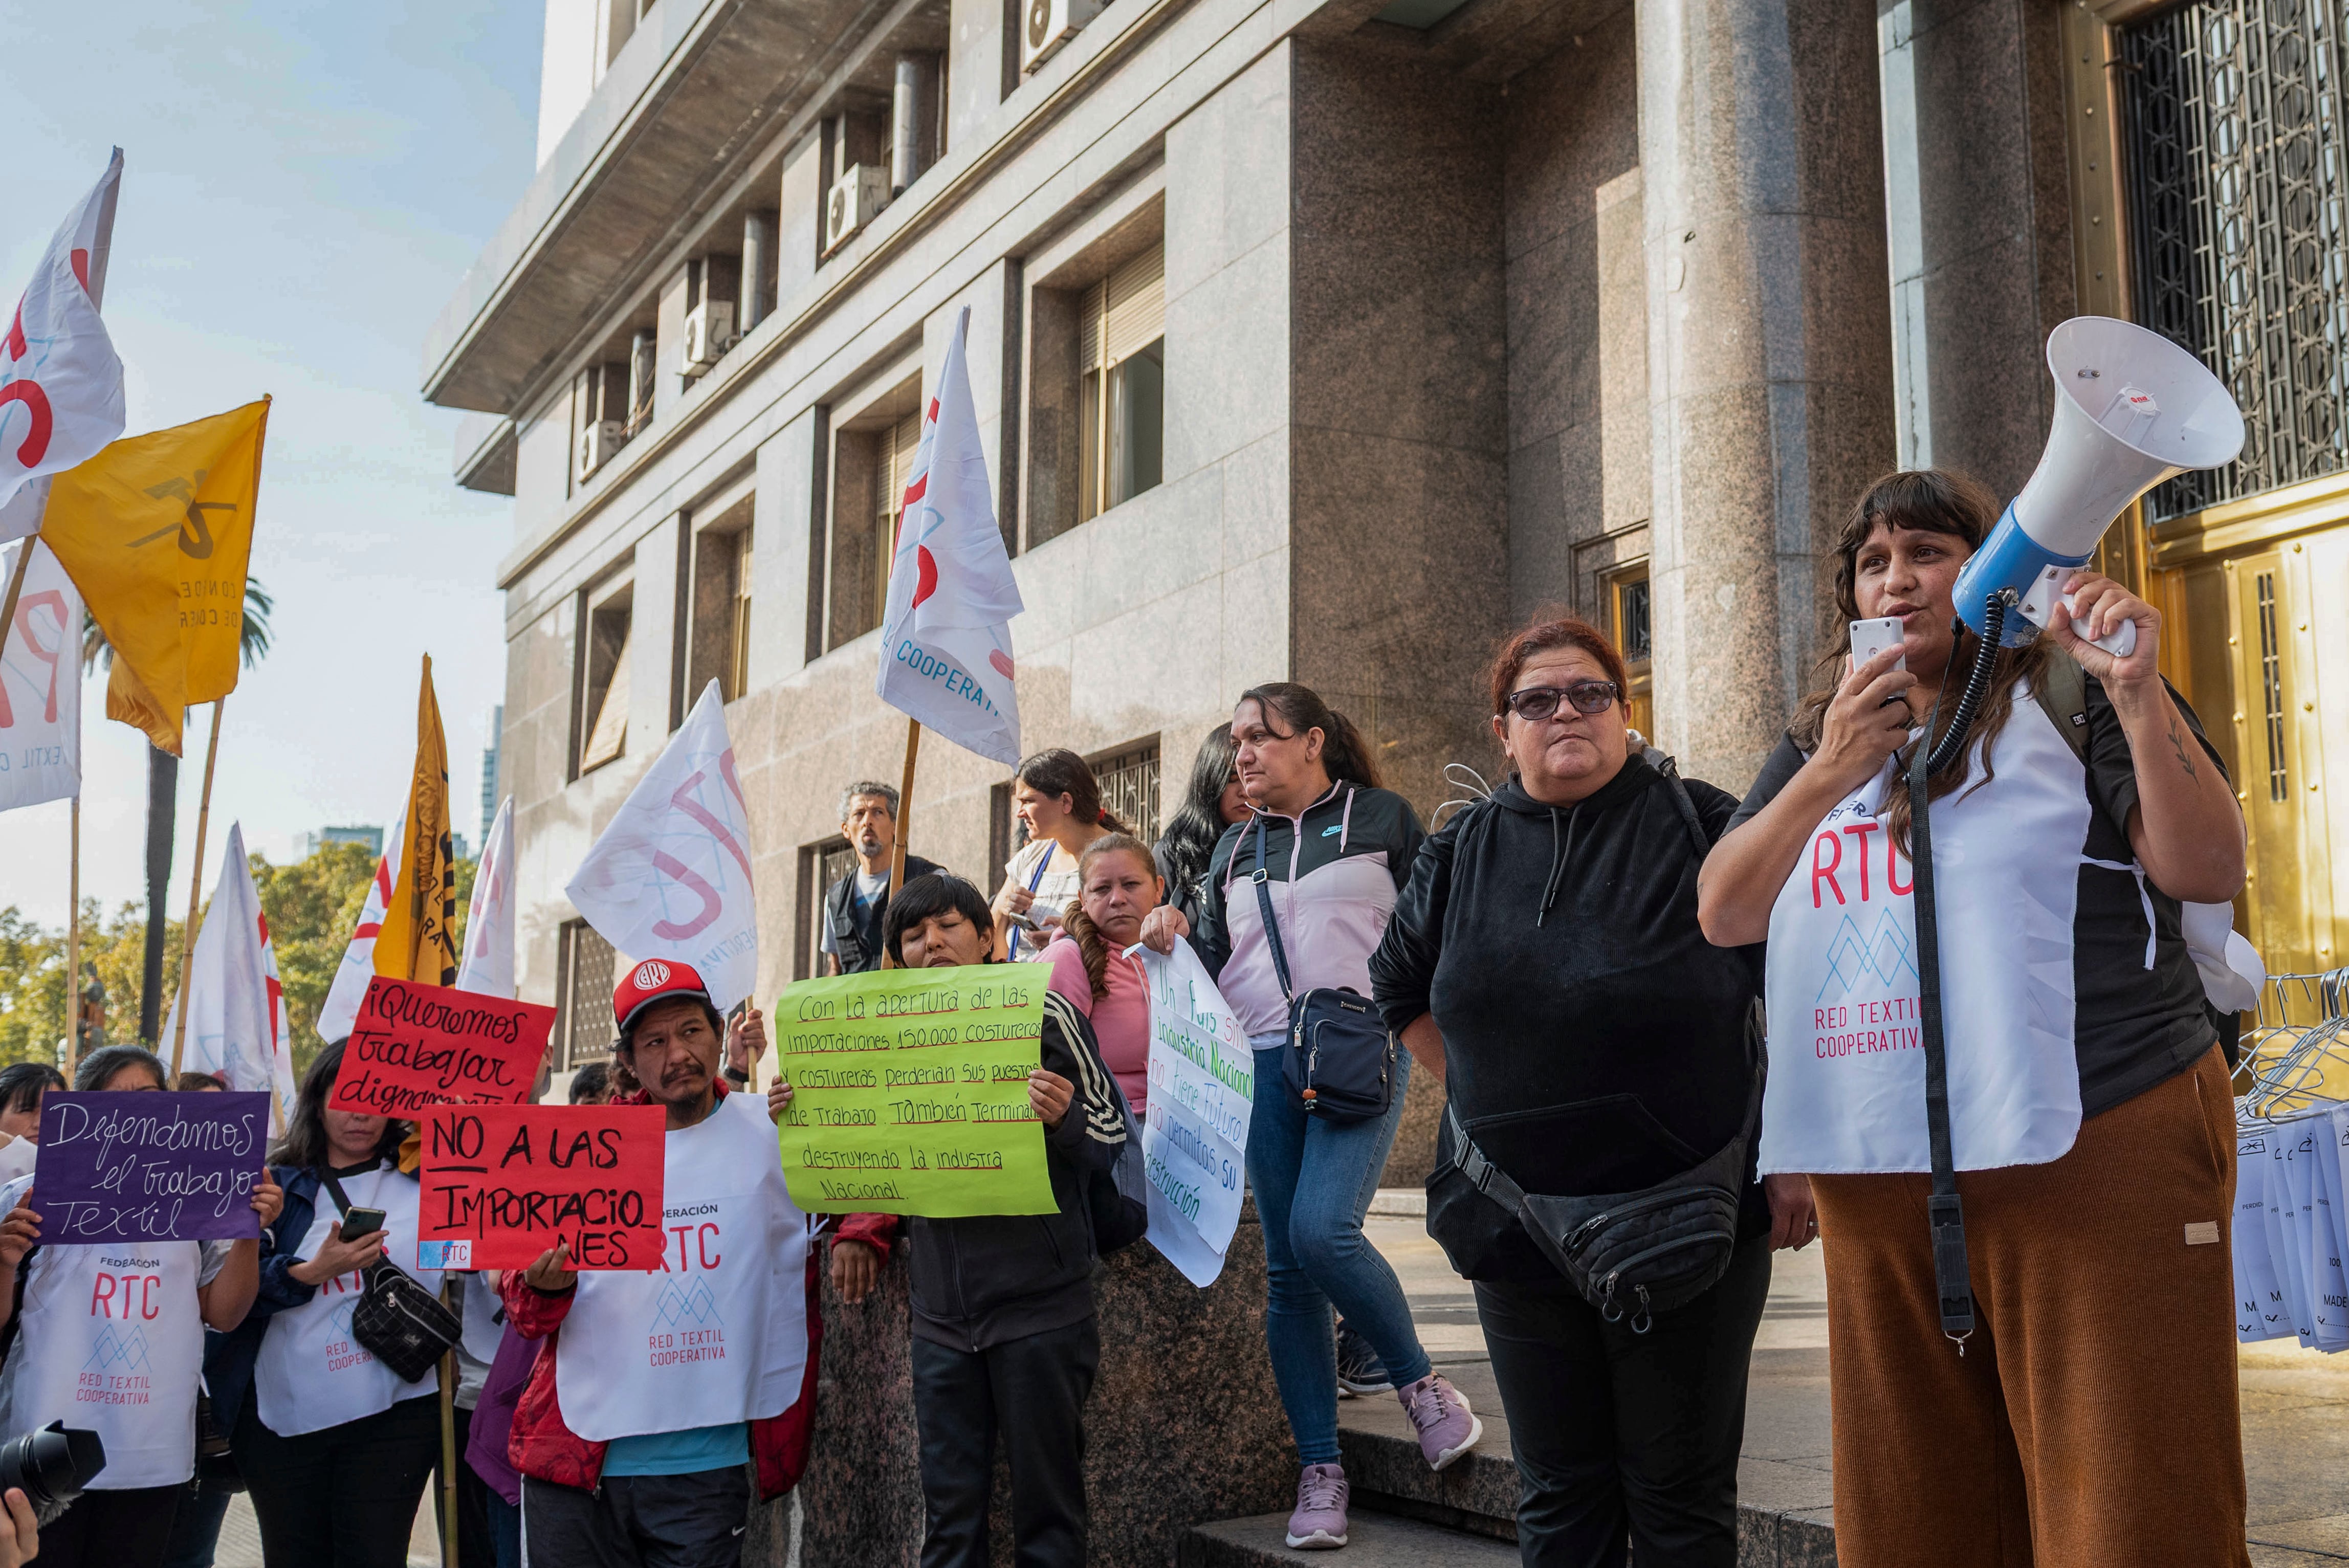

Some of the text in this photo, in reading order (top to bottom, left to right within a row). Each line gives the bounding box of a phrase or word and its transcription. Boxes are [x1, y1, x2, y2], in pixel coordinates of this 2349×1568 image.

[798, 995, 835, 1022] Con
[971, 986, 992, 1009] de
[1003, 984, 1028, 1007] las
[1159, 961, 1176, 1010] Un
[1224, 1016, 1244, 1051] sin
[1815, 1006, 1847, 1030] RED
[1157, 1015, 1254, 1103] industria Nacional
[1816, 1026, 1925, 1059] COOPERATIV
[885, 1066, 955, 1092] perderian
[1151, 1057, 1164, 1088] no
[1174, 1059, 1199, 1111] tiene
[789, 1103, 807, 1127] de
[46, 1103, 255, 1171] Defendamos
[432, 1112, 623, 1169] NO A LAS
[1149, 1100, 1237, 1192] no permitas su
[91, 1154, 136, 1195] el
[802, 1142, 901, 1174] destruyendo
[1144, 1143, 1200, 1223] destrucción
[47, 1198, 180, 1239] Textil
[442, 1245, 467, 1261] RTC
[556, 1231, 629, 1267] NES
[91, 1272, 161, 1320] RTC
[2323, 1294, 2347, 1308] MADE
[326, 1341, 348, 1357] RED
[649, 1329, 725, 1350] RED TEXTIL
[650, 1345, 726, 1367] COOPERATIVA
[76, 1388, 149, 1405] COOPERATIVA
[78, 1373, 151, 1389] RED TEXTIL
